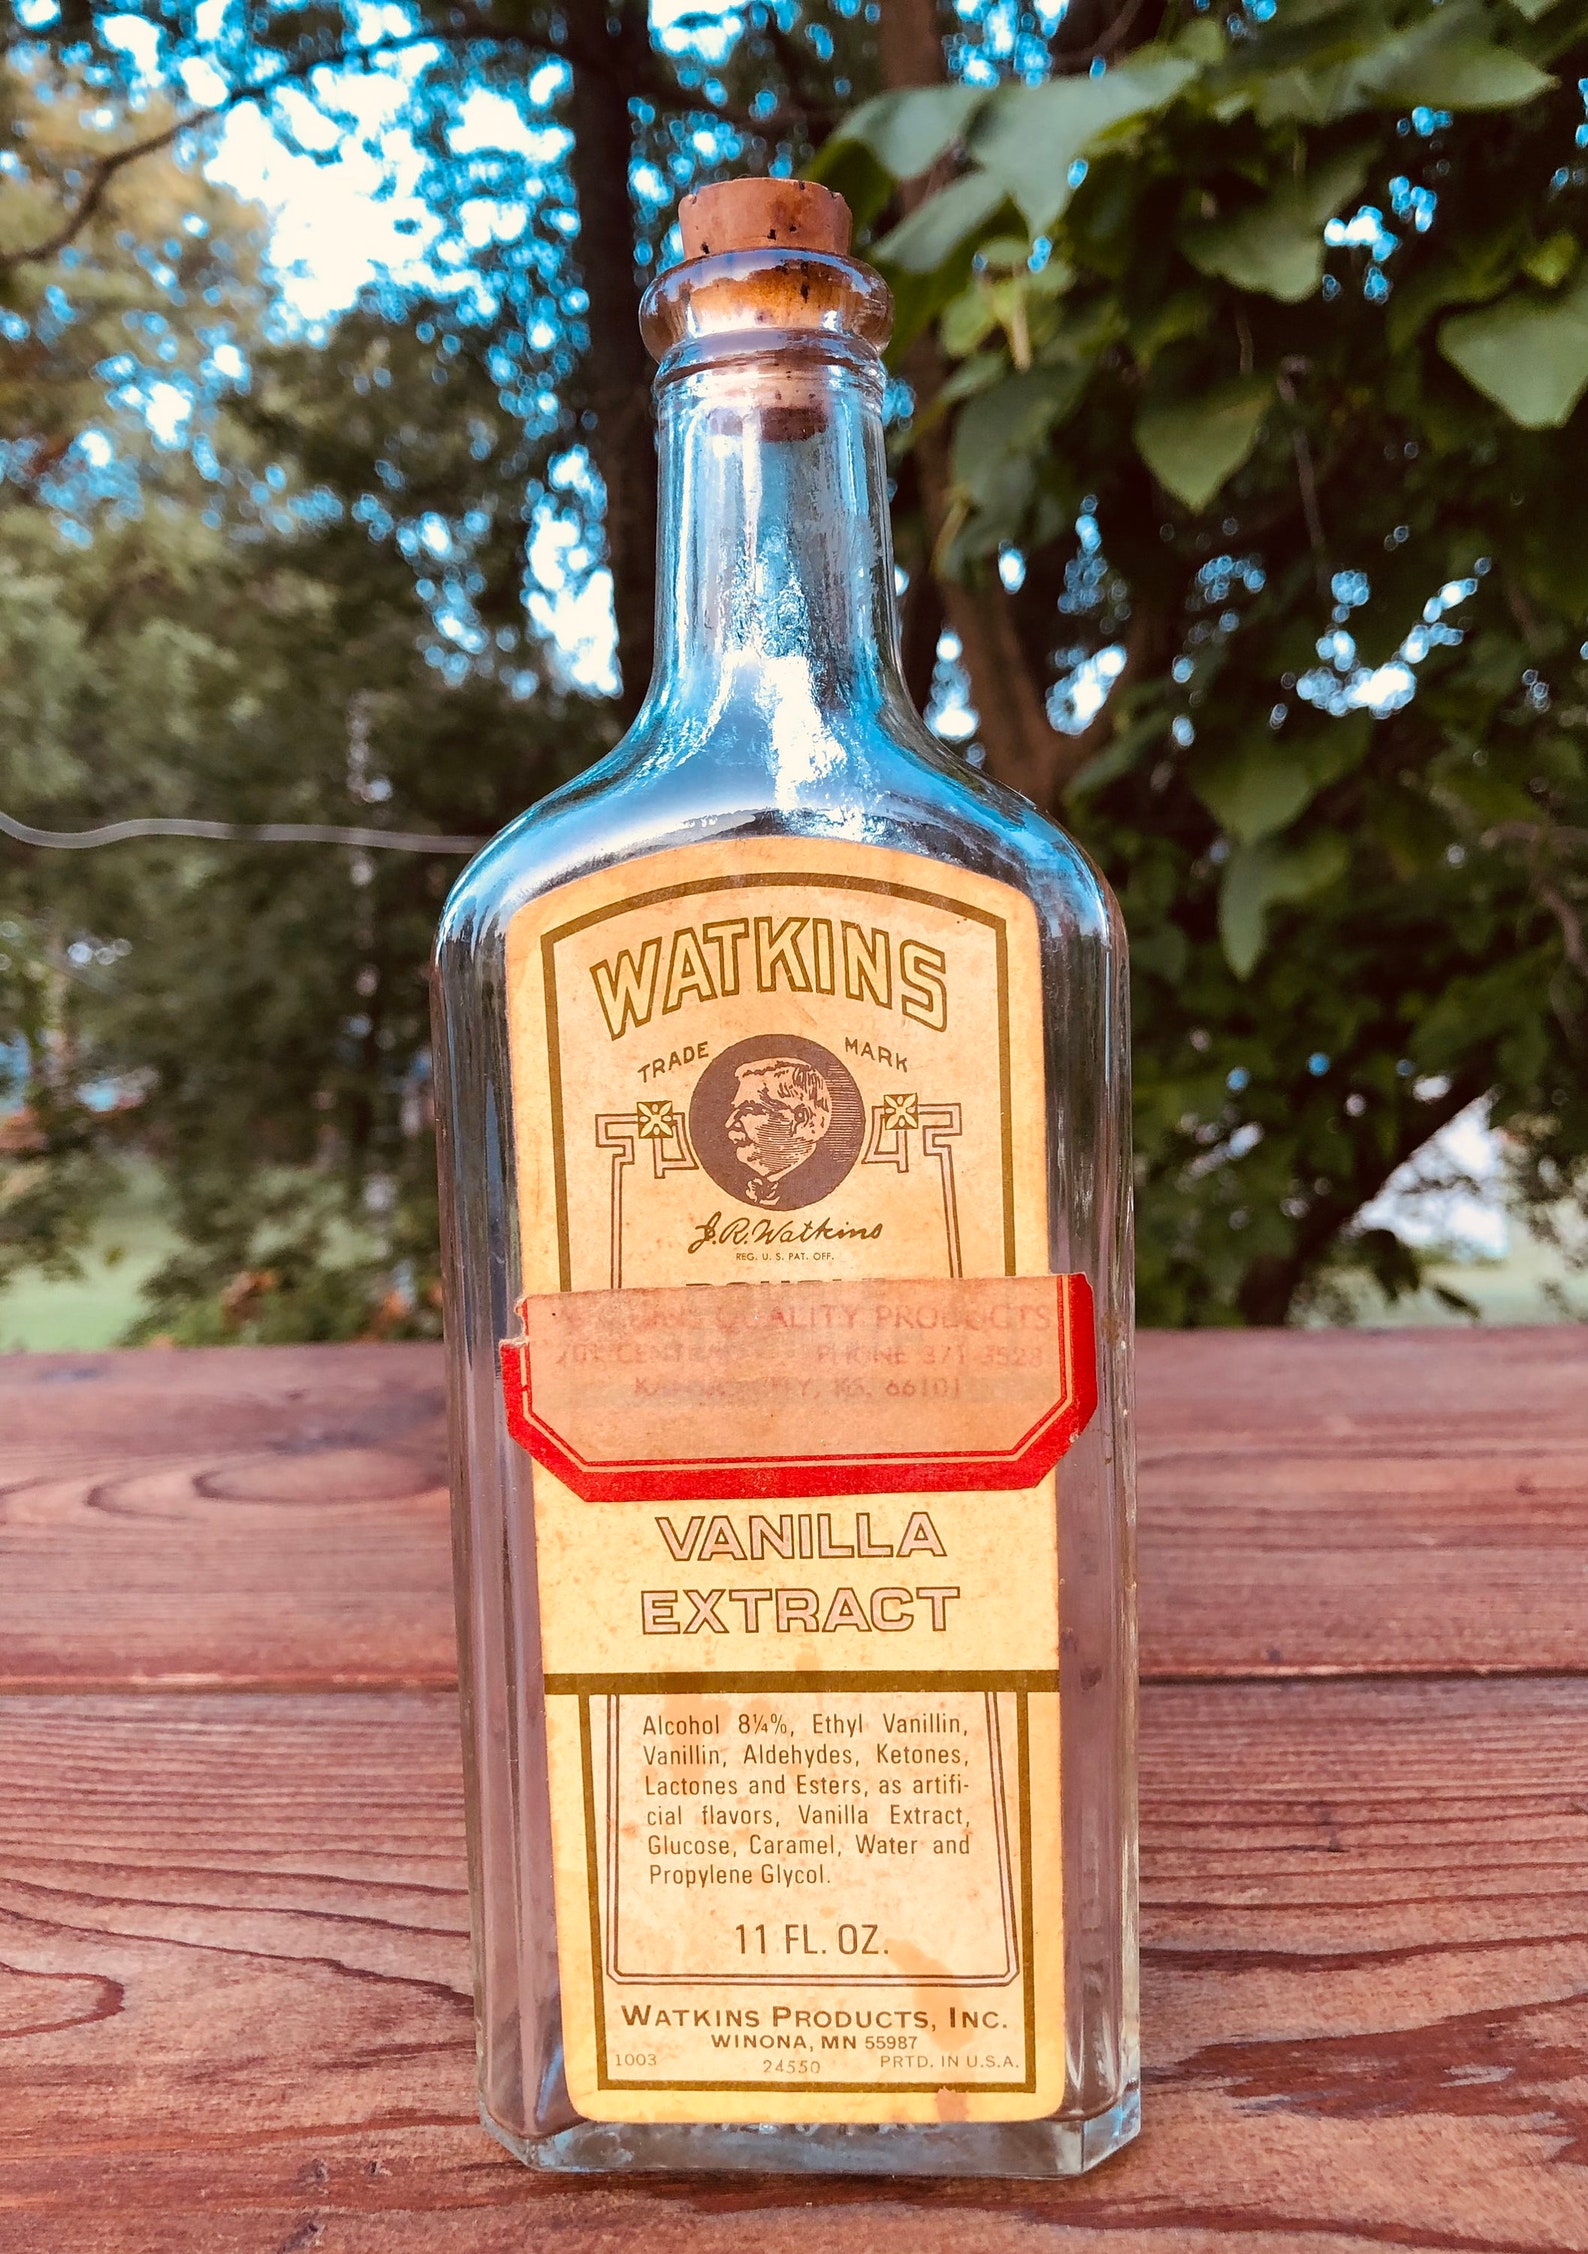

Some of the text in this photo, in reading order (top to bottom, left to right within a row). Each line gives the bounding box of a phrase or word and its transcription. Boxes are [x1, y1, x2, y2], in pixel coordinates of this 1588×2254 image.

[588, 915, 950, 1042] WATKINS
[637, 1036, 908, 1083] TRADE MARK
[735, 1251, 758, 1262] REG.
[787, 1251, 809, 1262] PAT.
[812, 1250, 835, 1262] OFF.
[885, 1377, 961, 1399] 66101
[654, 1511, 948, 1562] VANILLA
[640, 1586, 961, 1636] EXTRACT
[642, 1714, 720, 1736] Alcohol
[812, 1713, 863, 1738] Ethyl
[882, 1712, 968, 1737] Vanillin,
[643, 1743, 968, 1769] Vanillin, Aldehydes, Ketones,
[645, 1773, 969, 1798] Lactones and Esters, as artifi-
[647, 1803, 970, 1830] cial flavors, Vanilla Extract,
[648, 1833, 970, 1858] Glucose, Caramel, Water and
[650, 1863, 831, 1889] Propylene Glycol.
[735, 1923, 889, 1955] 11 FL. OZ.
[621, 2004, 1007, 2032] WATKINS PRODUCTS, INC.
[711, 2034, 918, 2052] WINONA, MN 55987
[615, 2053, 657, 2067] 1003
[762, 2058, 821, 2074] 24550
[880, 2055, 1019, 2069] PRTD. IN U.S.A.
